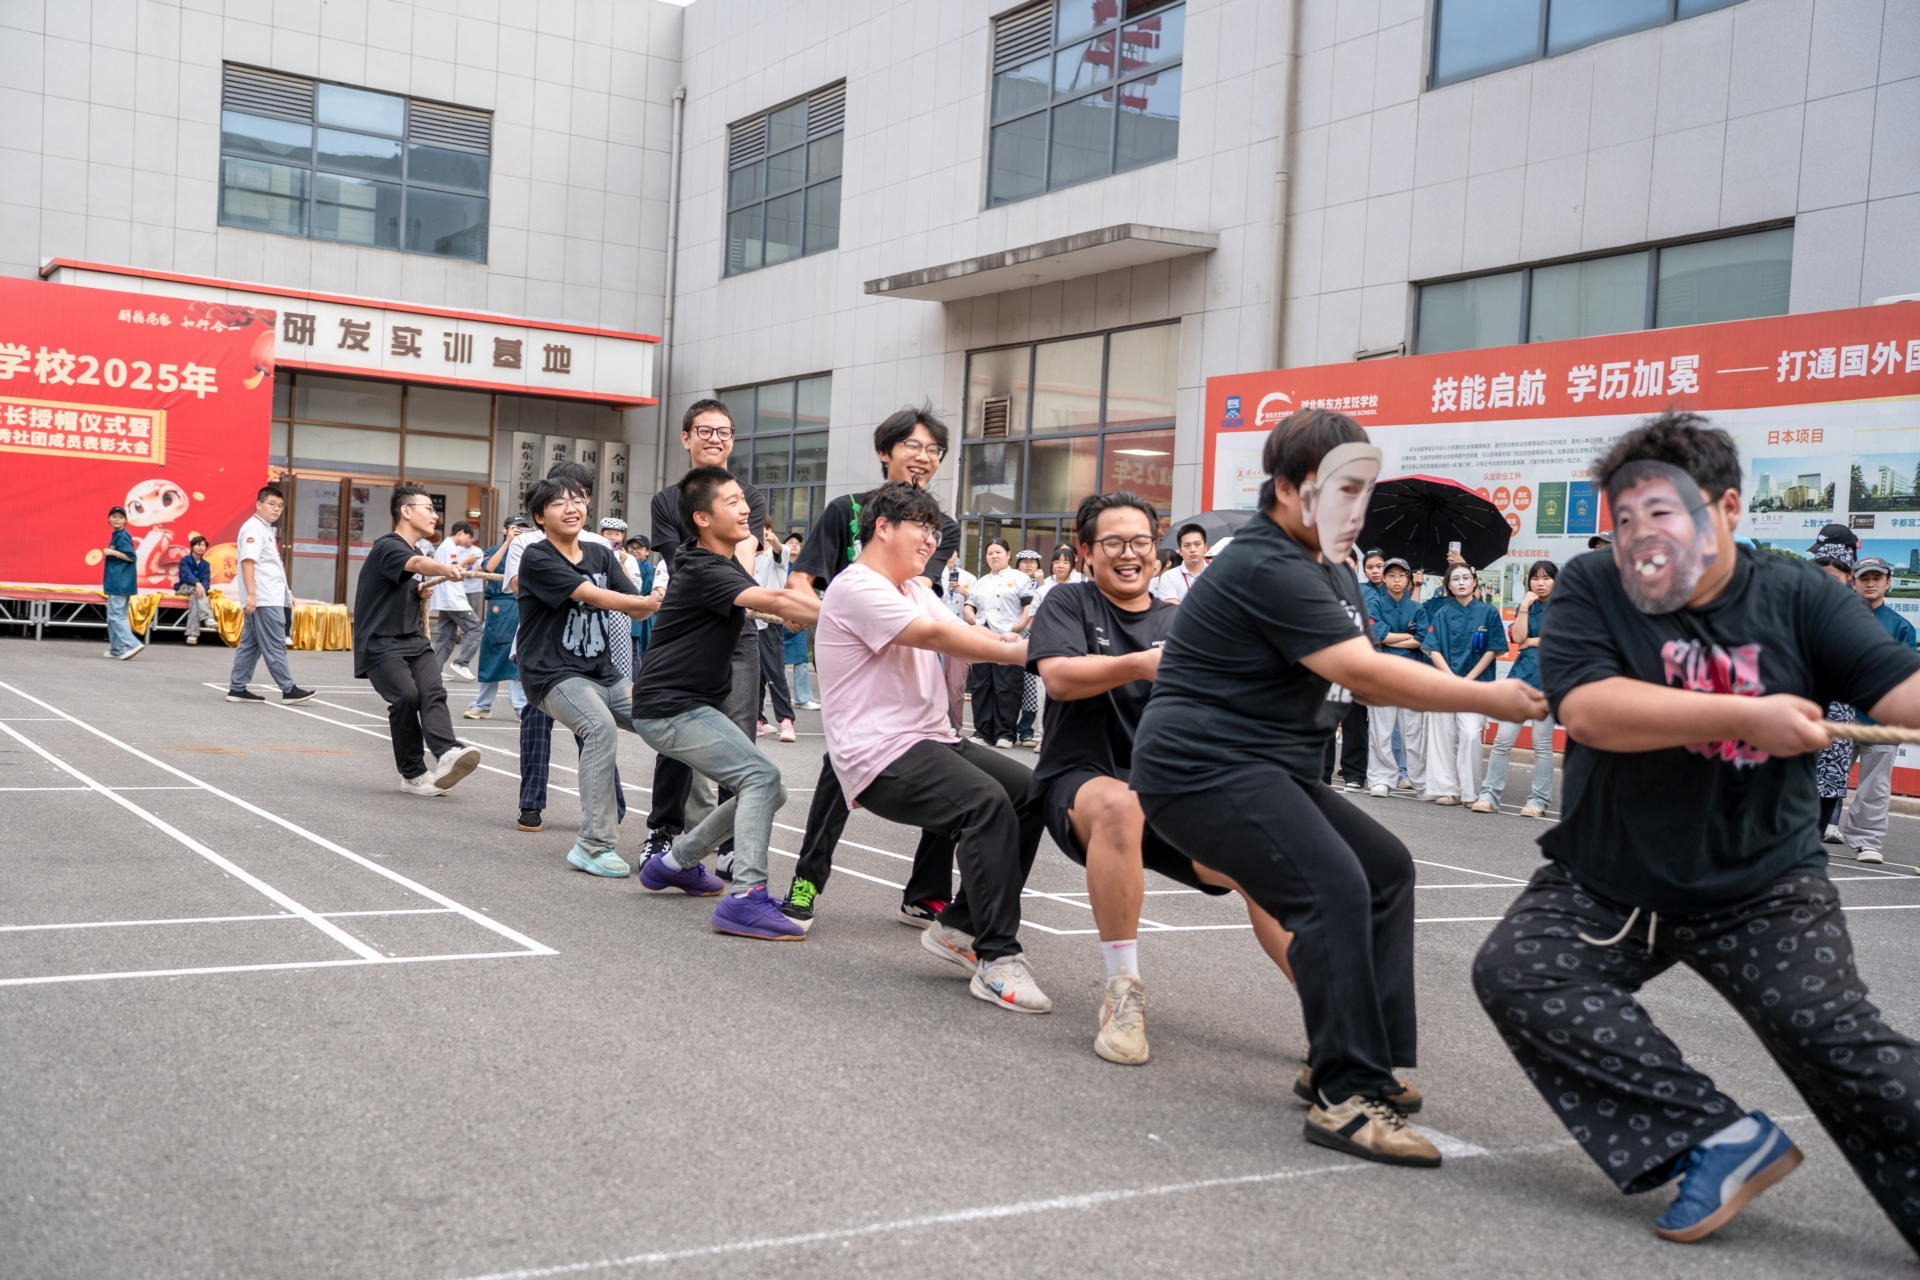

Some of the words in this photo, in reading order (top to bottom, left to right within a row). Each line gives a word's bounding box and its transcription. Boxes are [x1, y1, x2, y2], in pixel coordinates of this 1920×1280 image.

[283, 311, 571, 375] 研发实训基地
[0, 341, 218, 399] 学校2025年
[1431, 368, 1547, 413] 技能启航
[1566, 353, 1701, 403] 学历加冕
[0, 404, 151, 438] 长授帽仪式暨
[0, 428, 149, 455] 秀社团成员表彰大会
[1767, 428, 1824, 445] 日本项目
